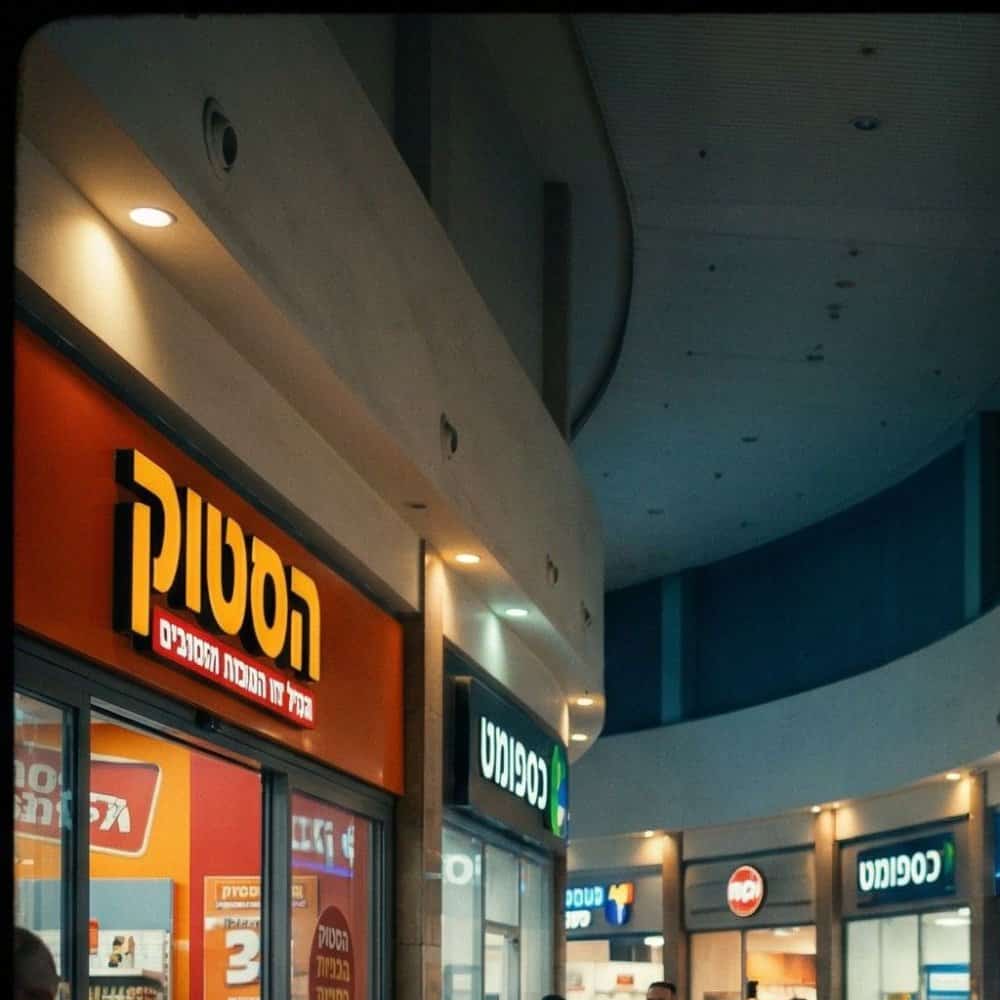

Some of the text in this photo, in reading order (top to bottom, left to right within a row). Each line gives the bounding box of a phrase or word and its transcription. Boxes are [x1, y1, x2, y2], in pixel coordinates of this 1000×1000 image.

[130, 448, 321, 681] הסטוק
[480, 716, 549, 811] כספומט
[858, 849, 942, 892] כספומט
